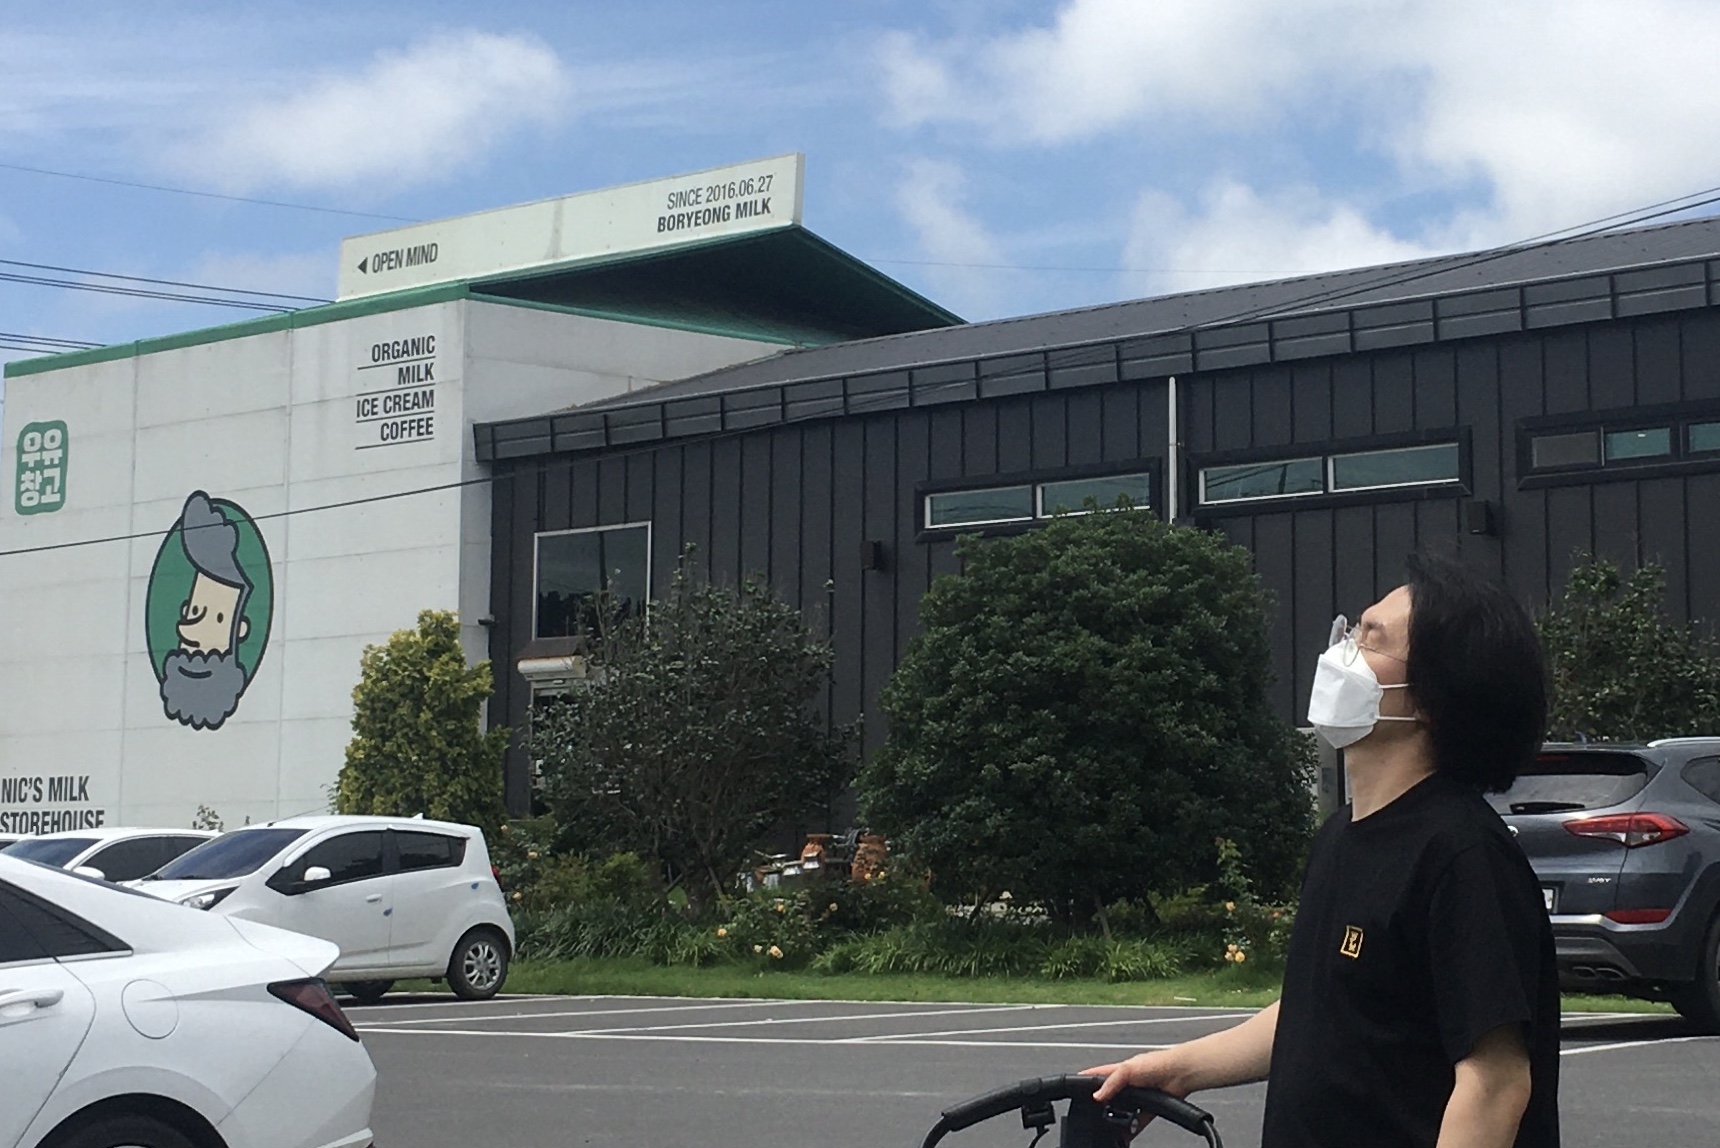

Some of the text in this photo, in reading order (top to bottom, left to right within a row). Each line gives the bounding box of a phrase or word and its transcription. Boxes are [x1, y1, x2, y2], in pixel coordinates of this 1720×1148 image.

[667, 174, 774, 210] SINCE 2016.06.27
[657, 197, 772, 233] BORYEONG MILK
[372, 242, 438, 273] OPEN MIND
[371, 335, 436, 363] ORGANIC
[398, 362, 435, 385] MILK
[356, 389, 435, 418] ICE CREAM
[380, 416, 434, 442] COFFEE
[48, 775, 90, 802] MILK
[0, 809, 105, 836] STOREHOUSE
